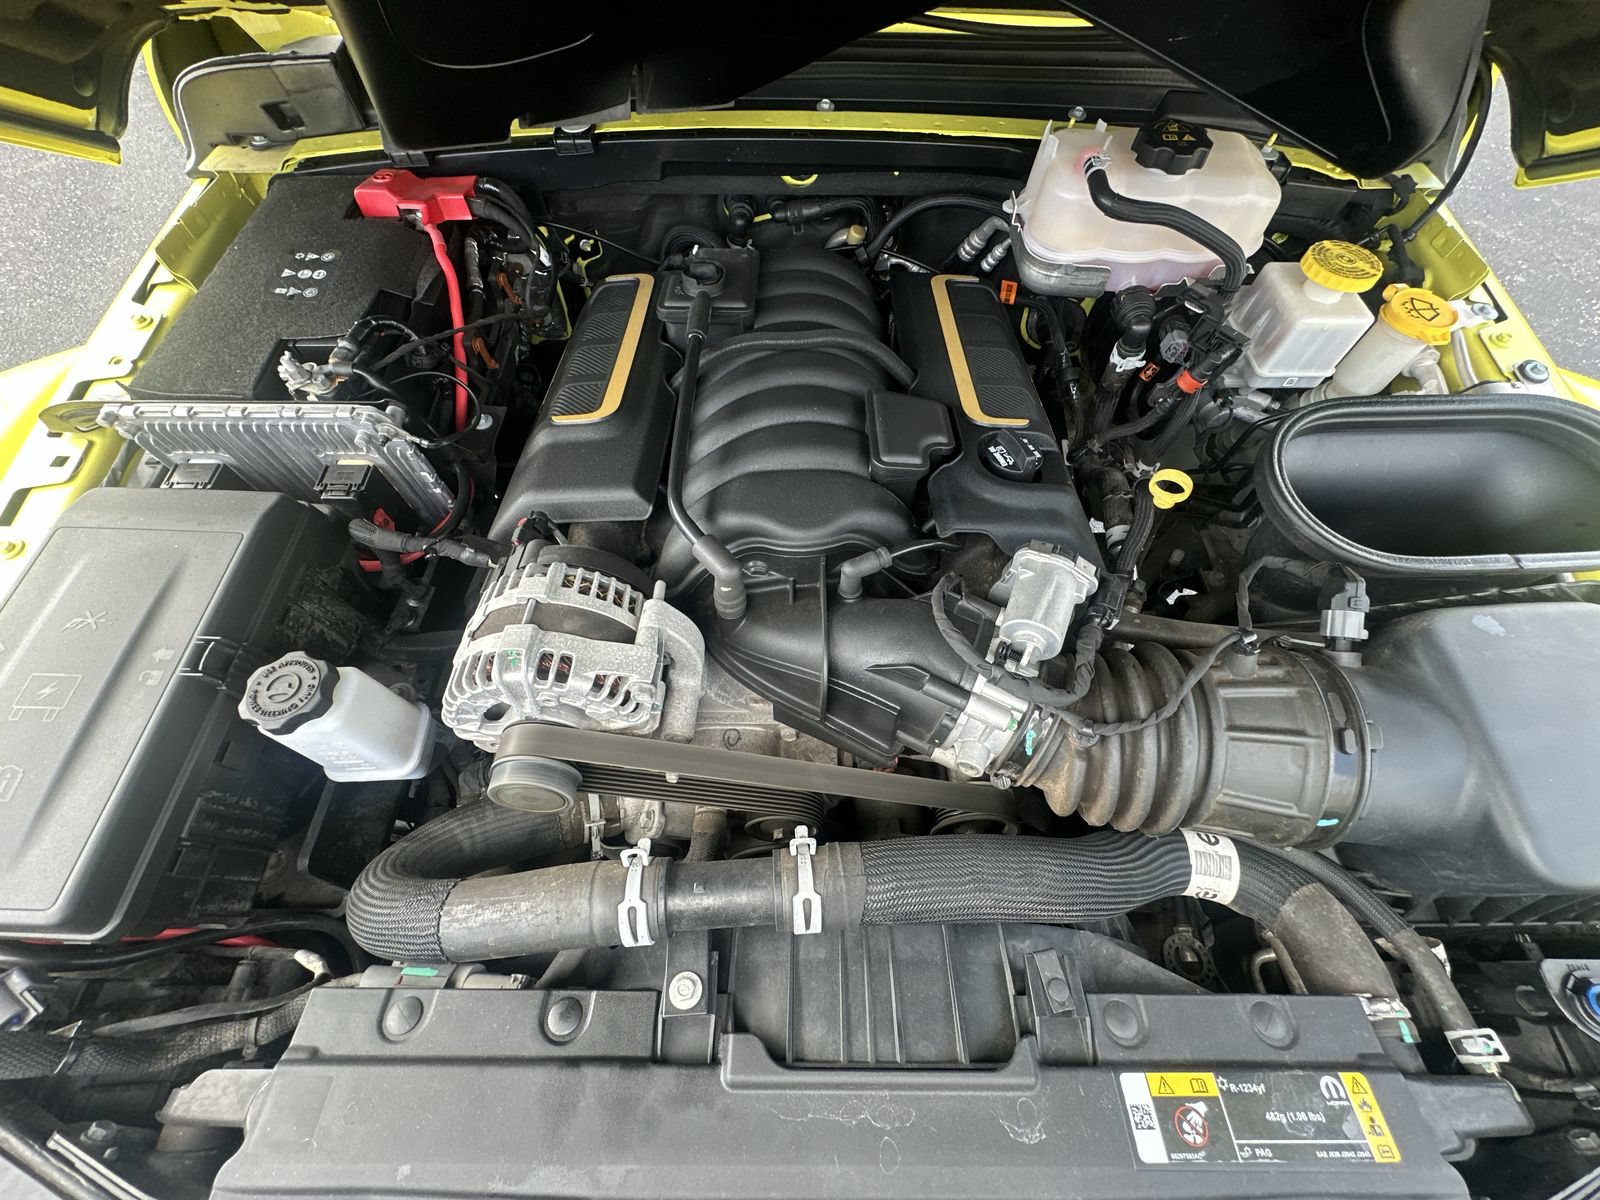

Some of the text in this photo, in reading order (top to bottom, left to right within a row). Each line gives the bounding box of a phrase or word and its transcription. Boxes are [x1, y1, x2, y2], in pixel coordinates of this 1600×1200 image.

[262, 666, 277, 678] USE
[1229, 1083, 1266, 1095] R-1234yf
[1265, 1112, 1287, 1123] 482g
[1254, 1148, 1273, 1157] PAG
